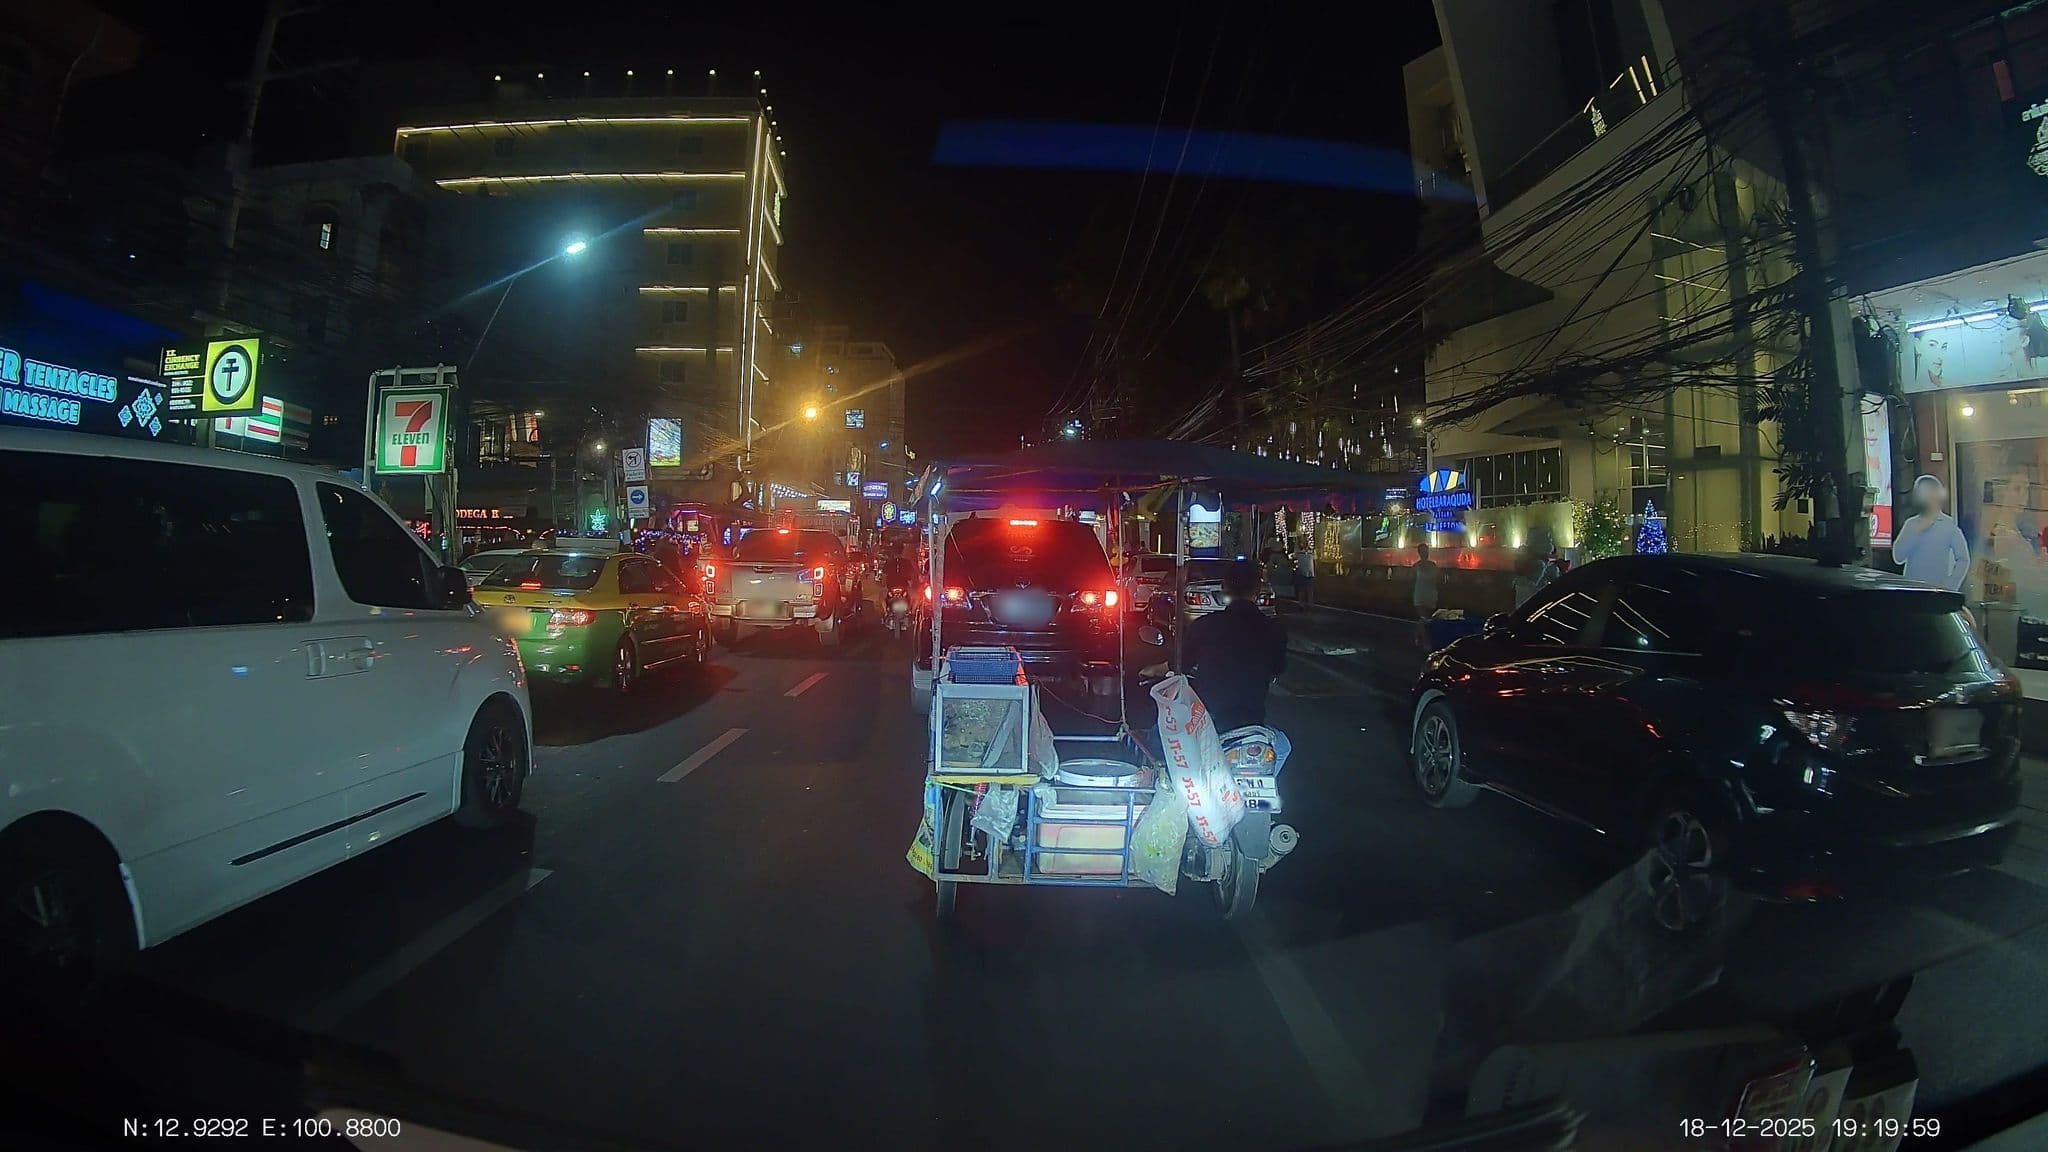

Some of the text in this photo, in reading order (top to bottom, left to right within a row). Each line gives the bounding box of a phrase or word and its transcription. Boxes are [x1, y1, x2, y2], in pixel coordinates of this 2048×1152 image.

[164, 362, 200, 371] EXCHANGE
[165, 354, 200, 364] CURRENCY
[25, 360, 116, 401] TENTACLES
[3, 389, 80, 424] MASSAGE
[395, 400, 433, 467] 7
[1168, 738, 1189, 769] JT-57
[1182, 776, 1201, 808] JT-57
[1196, 815, 1218, 844] JT-57
